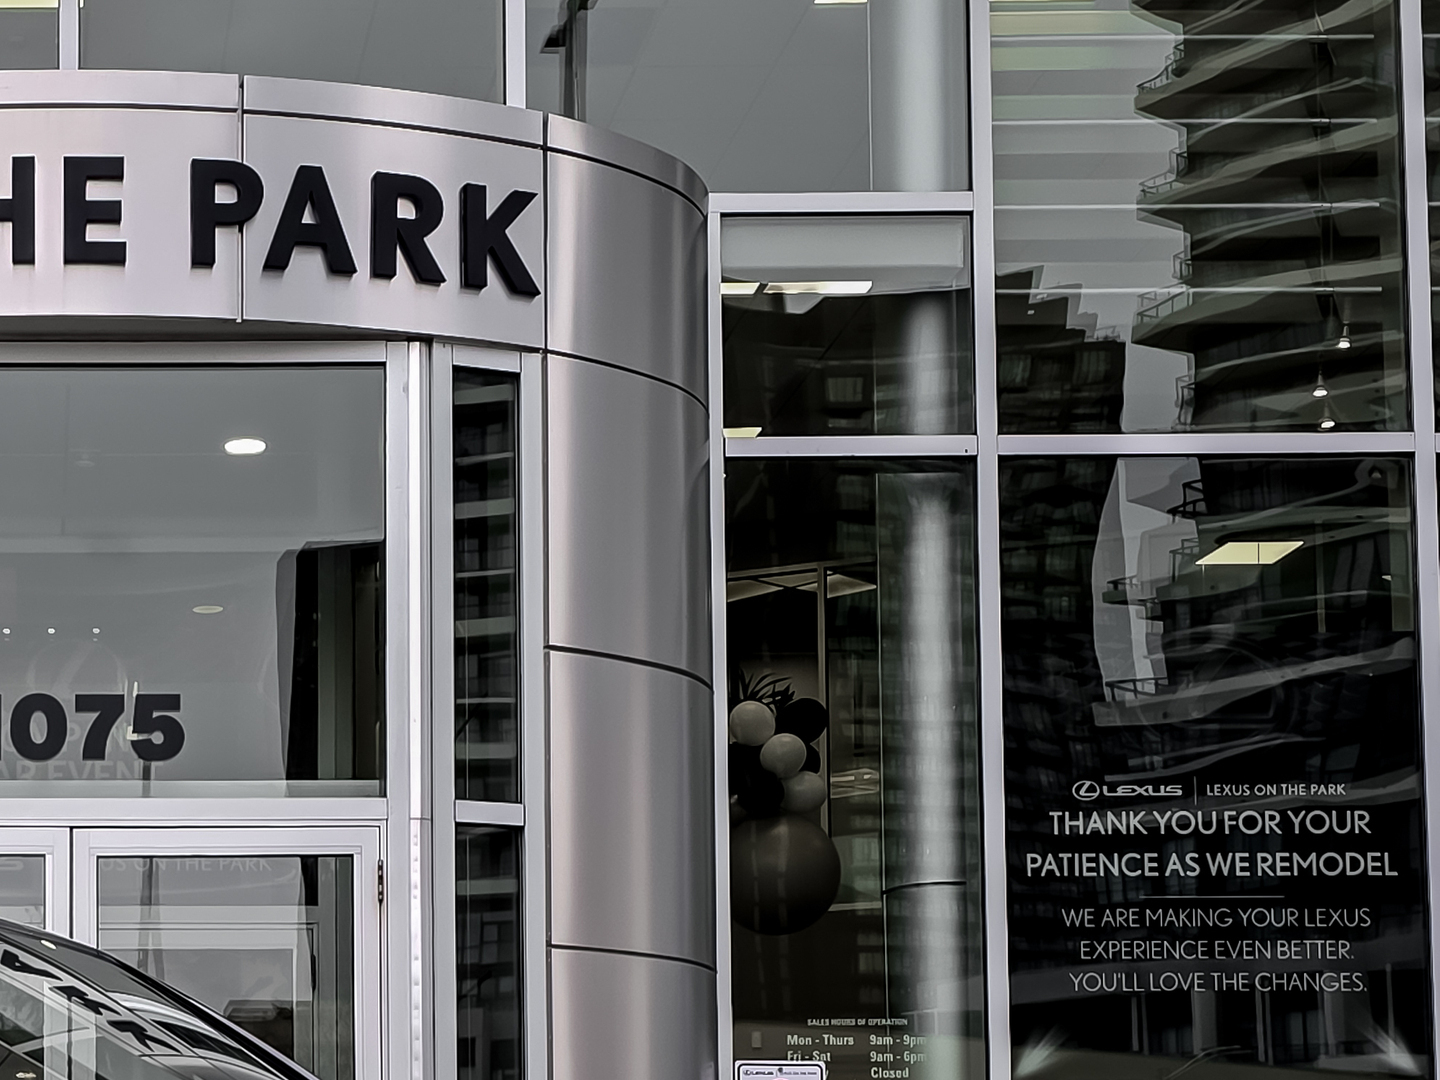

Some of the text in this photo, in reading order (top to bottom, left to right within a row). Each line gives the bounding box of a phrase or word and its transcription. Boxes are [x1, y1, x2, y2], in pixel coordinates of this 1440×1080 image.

[189, 157, 541, 298] PARK
[1102, 784, 1182, 797] LEXUS
[1206, 783, 1347, 797] LEXUS ON THE PARK
[1049, 810, 1372, 836] THANK YOU FOR YOUR
[219, 858, 272, 873] PARK
[1026, 852, 1399, 878] PATIENCE AS WE REMODEL
[1061, 908, 1372, 928] WE ARE MAKING YOUR LEXUS
[1080, 940, 1355, 960] EXPERIENCE EVEN BETTER.
[1069, 972, 1368, 993] YOU'LL LOVE THE CHANGES.
[787, 1034, 812, 1045] Mon
[822, 1033, 854, 1045] Thurs
[869, 1034, 894, 1045] 9am
[903, 1034, 928, 1048] 9pm
[787, 1050, 802, 1061] Fri
[812, 1050, 831, 1061] Sat
[869, 1051, 894, 1061] 9am
[903, 1051, 928, 1064] 6pm
[871, 1066, 909, 1078] Closed
